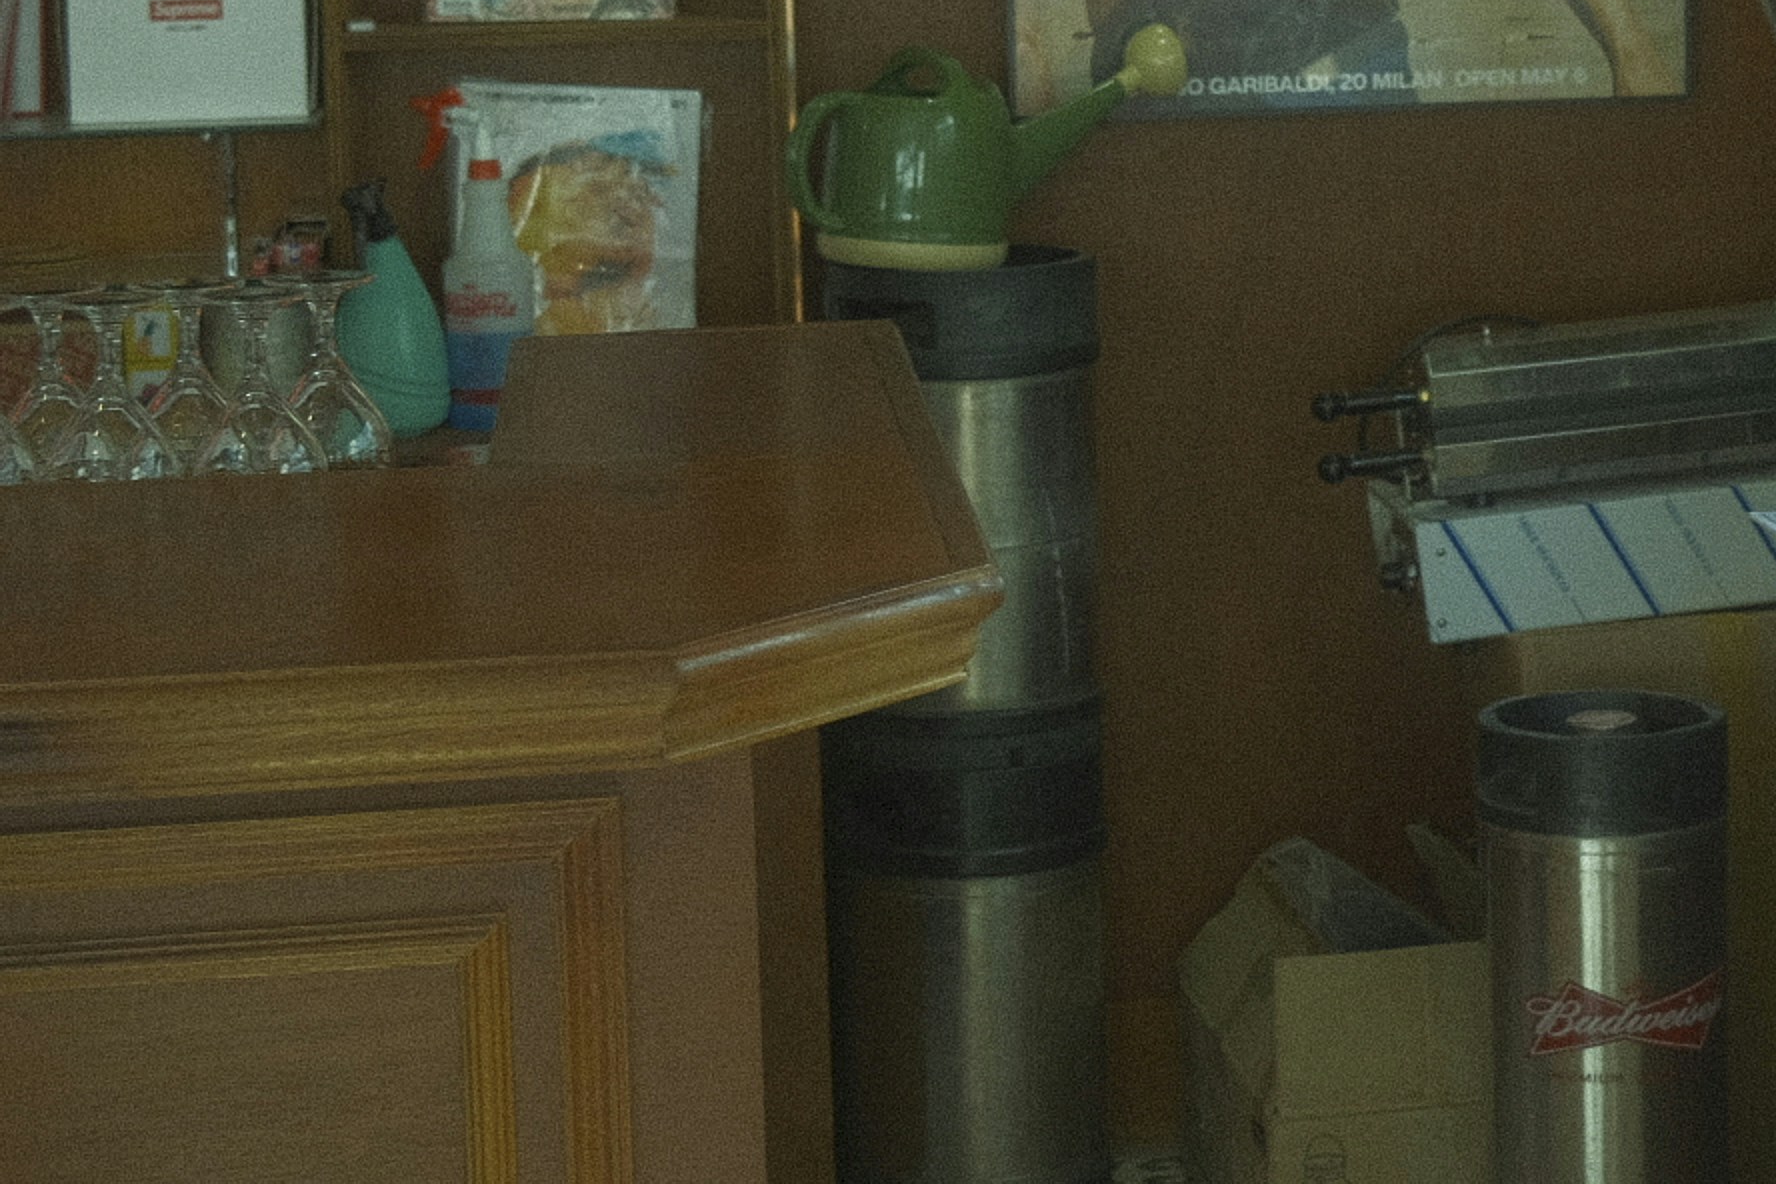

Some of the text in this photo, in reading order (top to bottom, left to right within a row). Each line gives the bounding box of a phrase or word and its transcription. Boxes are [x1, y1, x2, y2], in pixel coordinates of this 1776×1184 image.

[1208, 73, 1336, 96] GARIBALDI,
[1339, 73, 1367, 91] 20
[1373, 70, 1443, 89] MILAN
[1454, 69, 1516, 87] OPEN
[1520, 68, 1569, 85] MAY
[1525, 995, 1722, 1038] Budweiser
